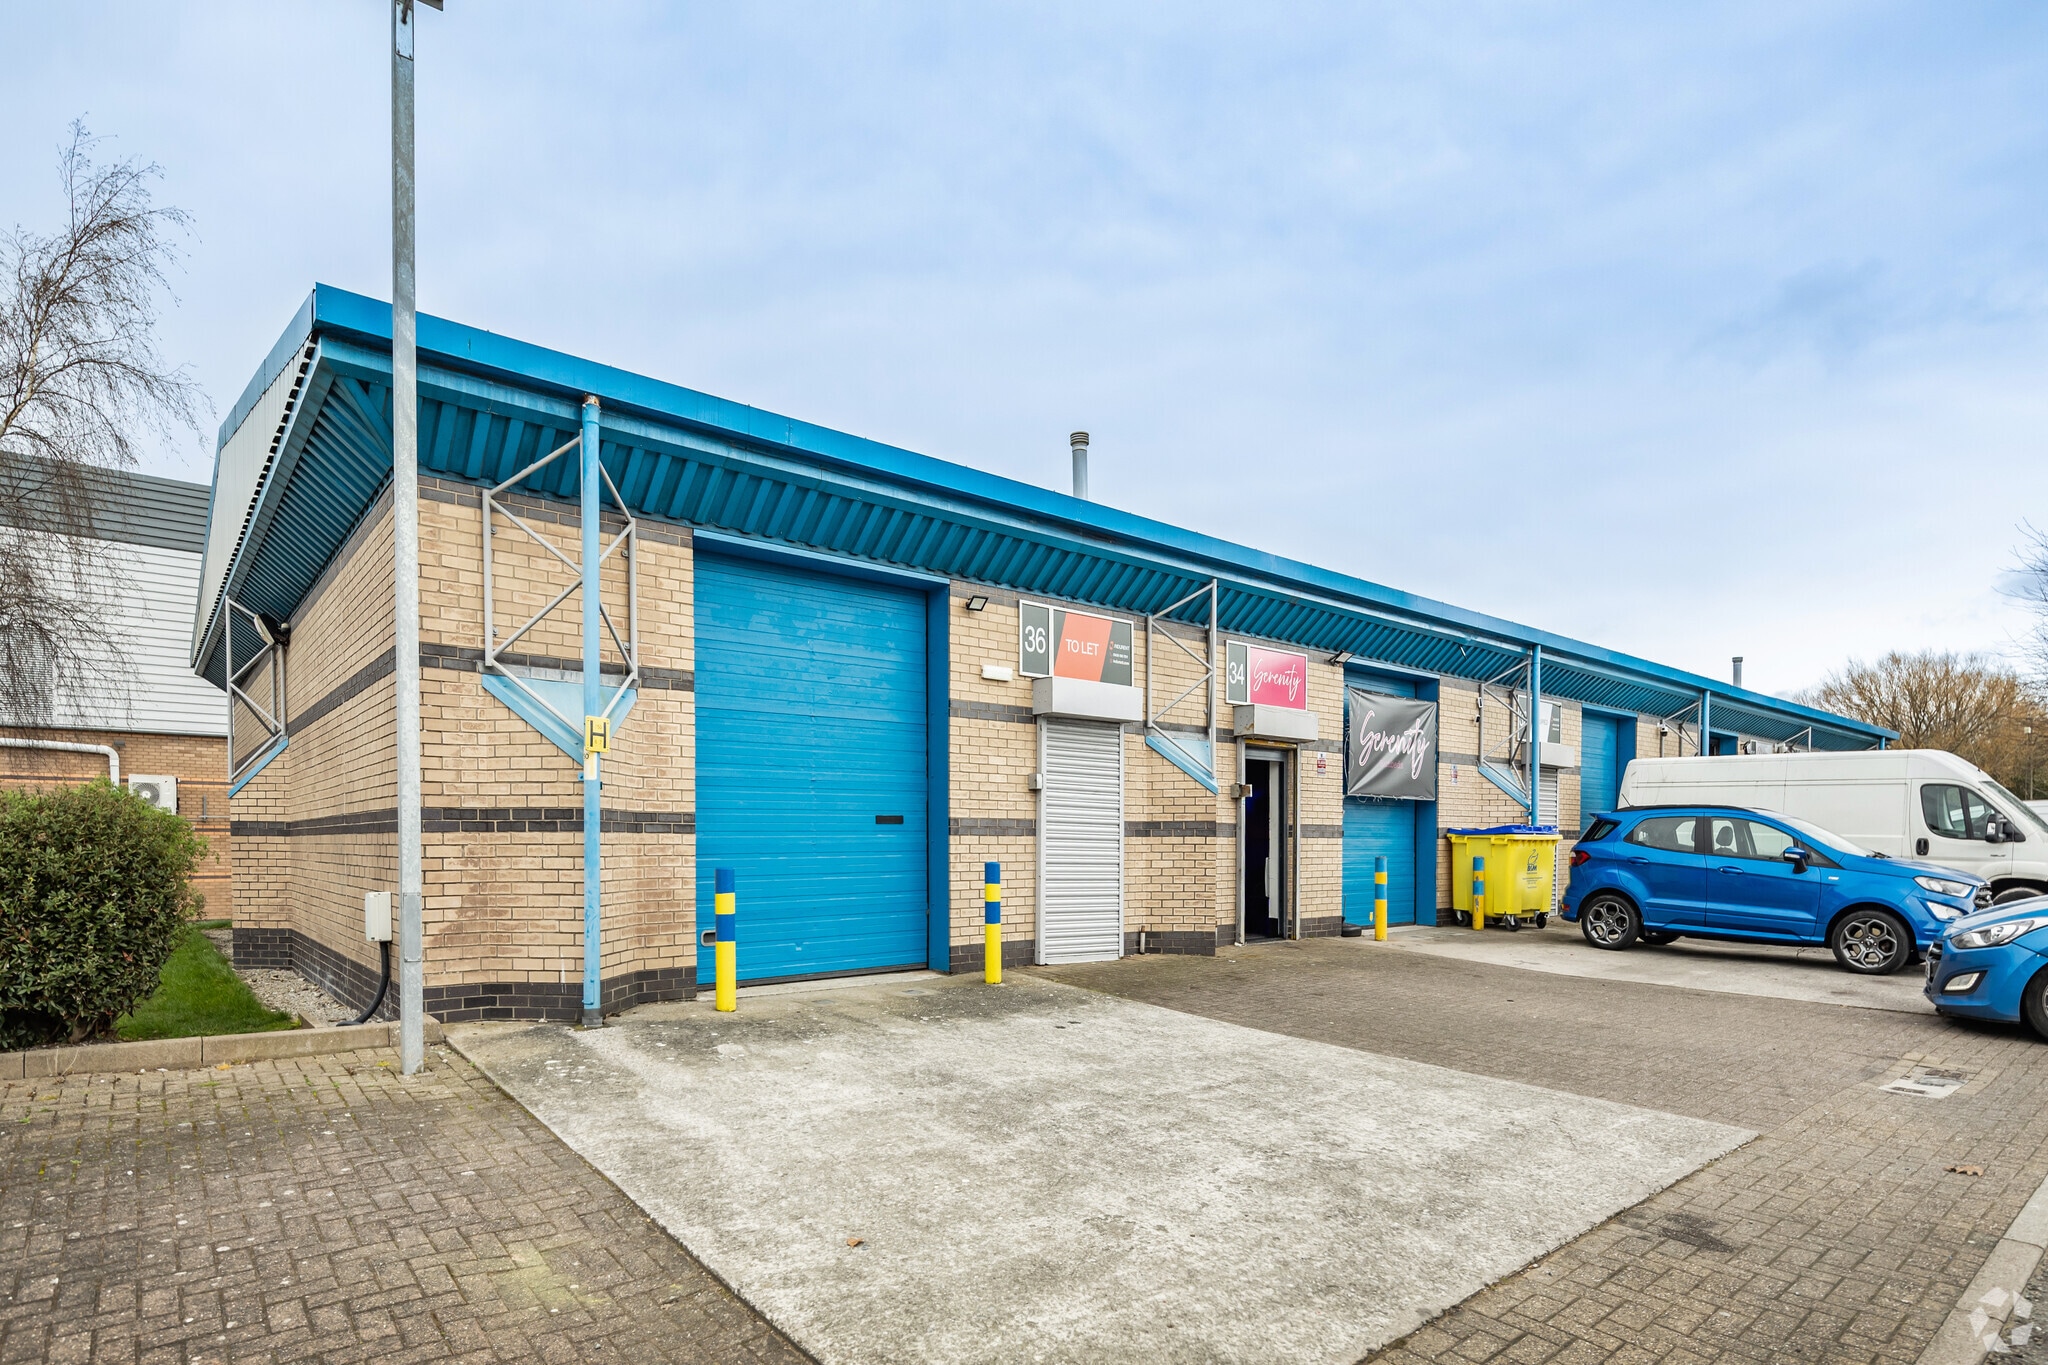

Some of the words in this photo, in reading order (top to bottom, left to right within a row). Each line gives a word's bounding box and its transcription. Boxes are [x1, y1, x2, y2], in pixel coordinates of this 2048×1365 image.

[1024, 625, 1047, 654] 36
[1065, 638, 1080, 653] TO
[1081, 641, 1100, 656] LET
[1229, 661, 1245, 685] 34
[1253, 658, 1302, 702] Serenity
[590, 720, 606, 749] H
[1359, 710, 1431, 780] Serenity
